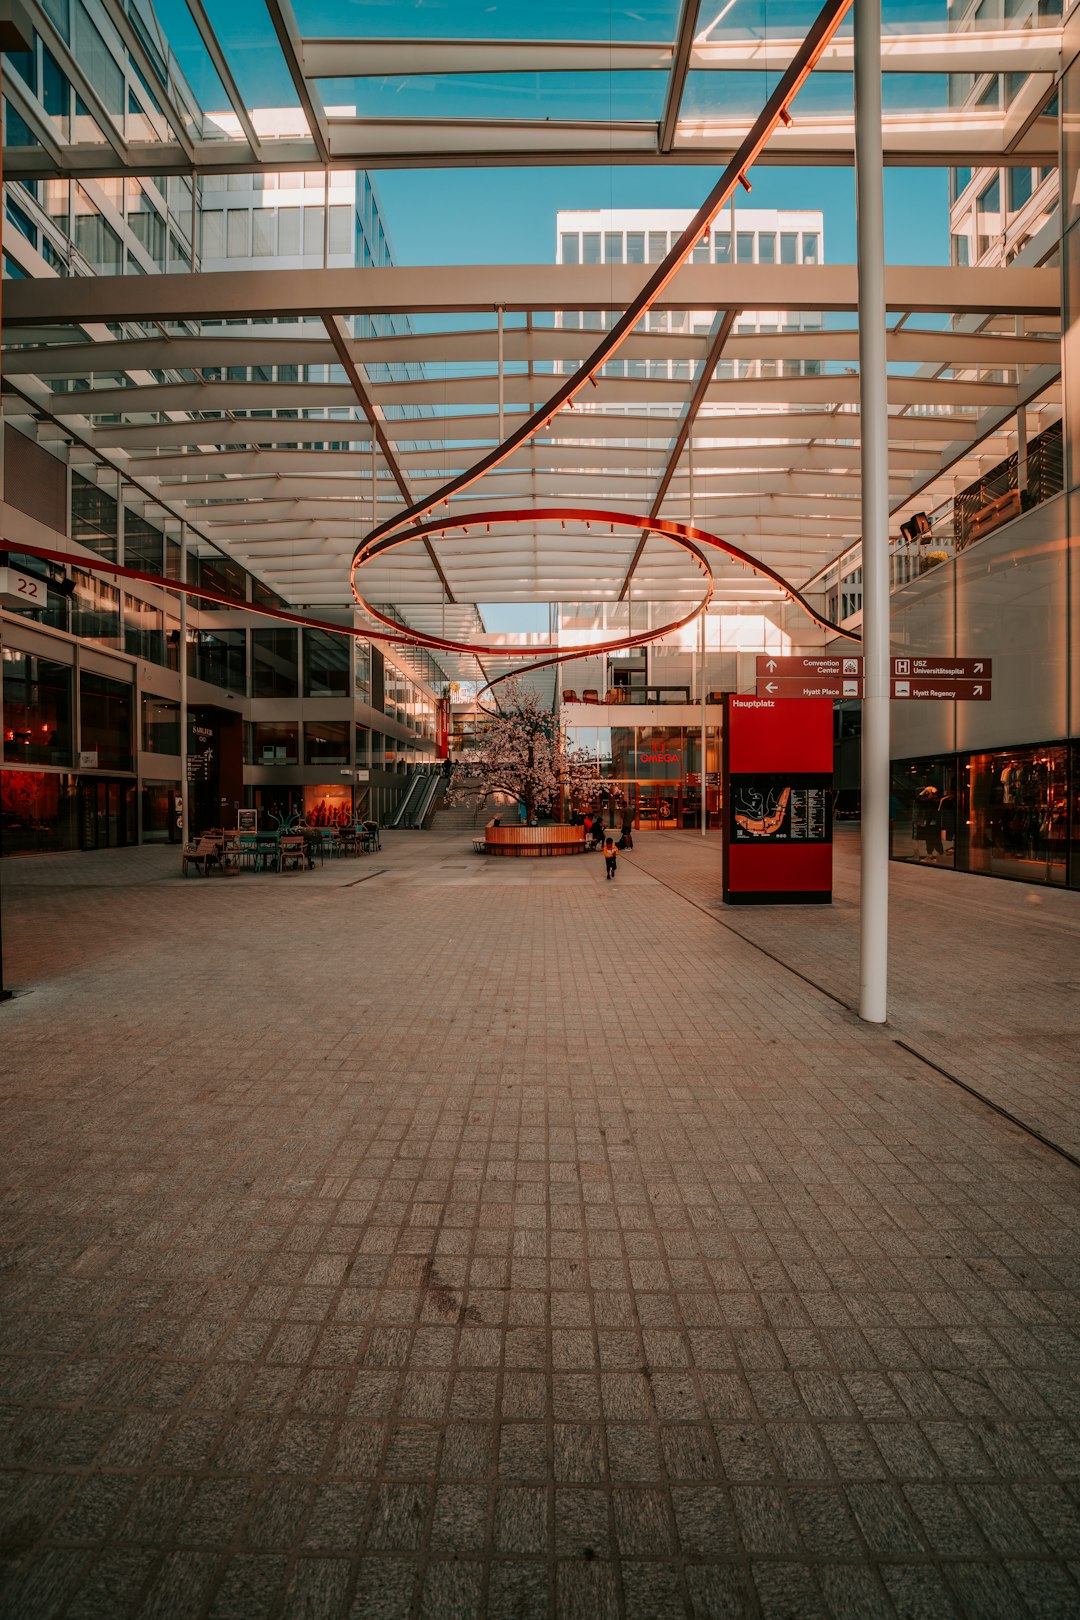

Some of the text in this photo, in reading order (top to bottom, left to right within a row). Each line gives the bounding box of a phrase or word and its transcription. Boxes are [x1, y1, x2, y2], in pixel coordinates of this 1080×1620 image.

[17, 577, 38, 598] 22
[913, 667, 965, 675] Universitätsspital
[930, 690, 956, 698] Regency
[732, 700, 775, 709] Hauptplatz
[639, 753, 679, 763] OMEGA
